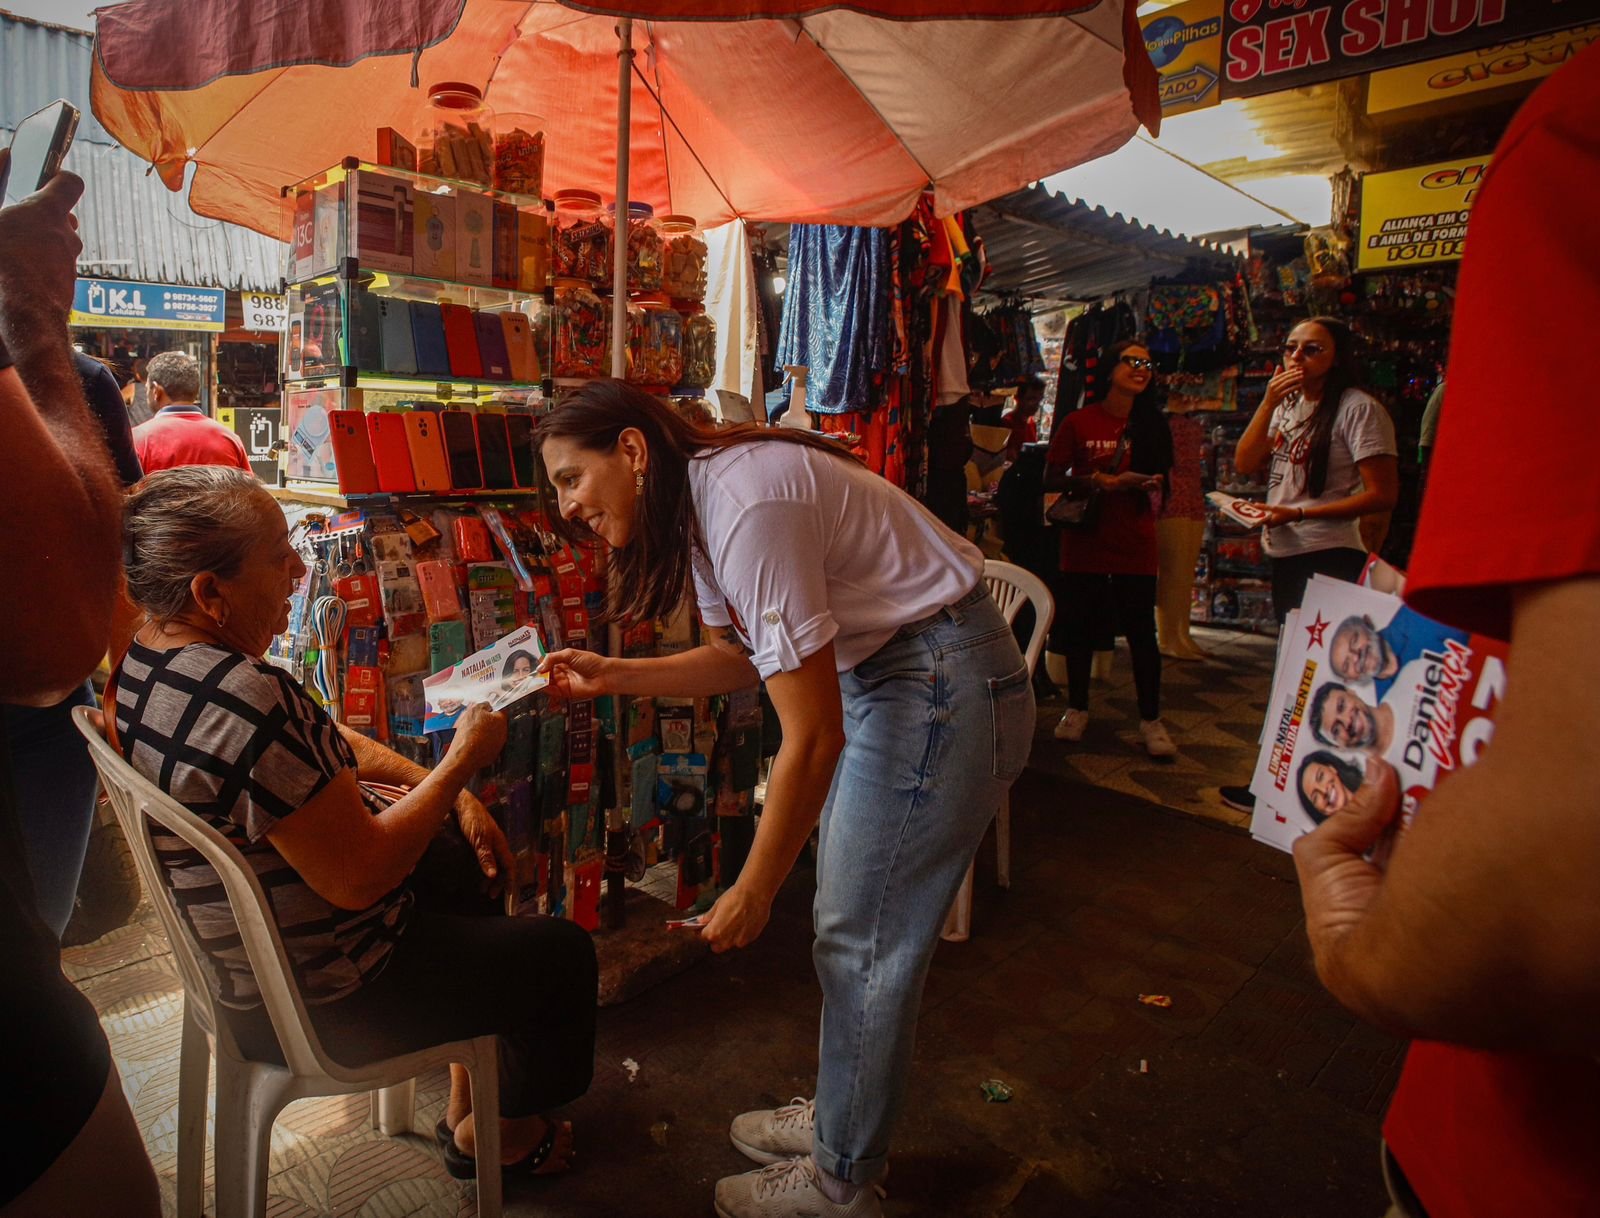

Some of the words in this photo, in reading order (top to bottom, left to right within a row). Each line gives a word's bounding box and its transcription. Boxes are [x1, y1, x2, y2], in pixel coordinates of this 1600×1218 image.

[1173, 22, 1219, 46] Pilhas
[1226, 6, 1332, 82] SEX
[1369, 234, 1379, 248] E
[1380, 233, 1410, 246] ANEL
[1412, 230, 1432, 243] DE
[1382, 213, 1434, 232] ALIANÇA
[1436, 211, 1457, 226] EM
[1387, 246, 1418, 260] 16
[1418, 243, 1437, 257] E
[108, 288, 147, 311] K.L
[1403, 651, 1446, 771] Daniel
[1427, 638, 1472, 770] VALENÇA
[1268, 744, 1281, 776] UMA
[1277, 704, 1294, 746] NATAL
[1276, 757, 1290, 789] PRA
[1283, 724, 1300, 757] TODA
